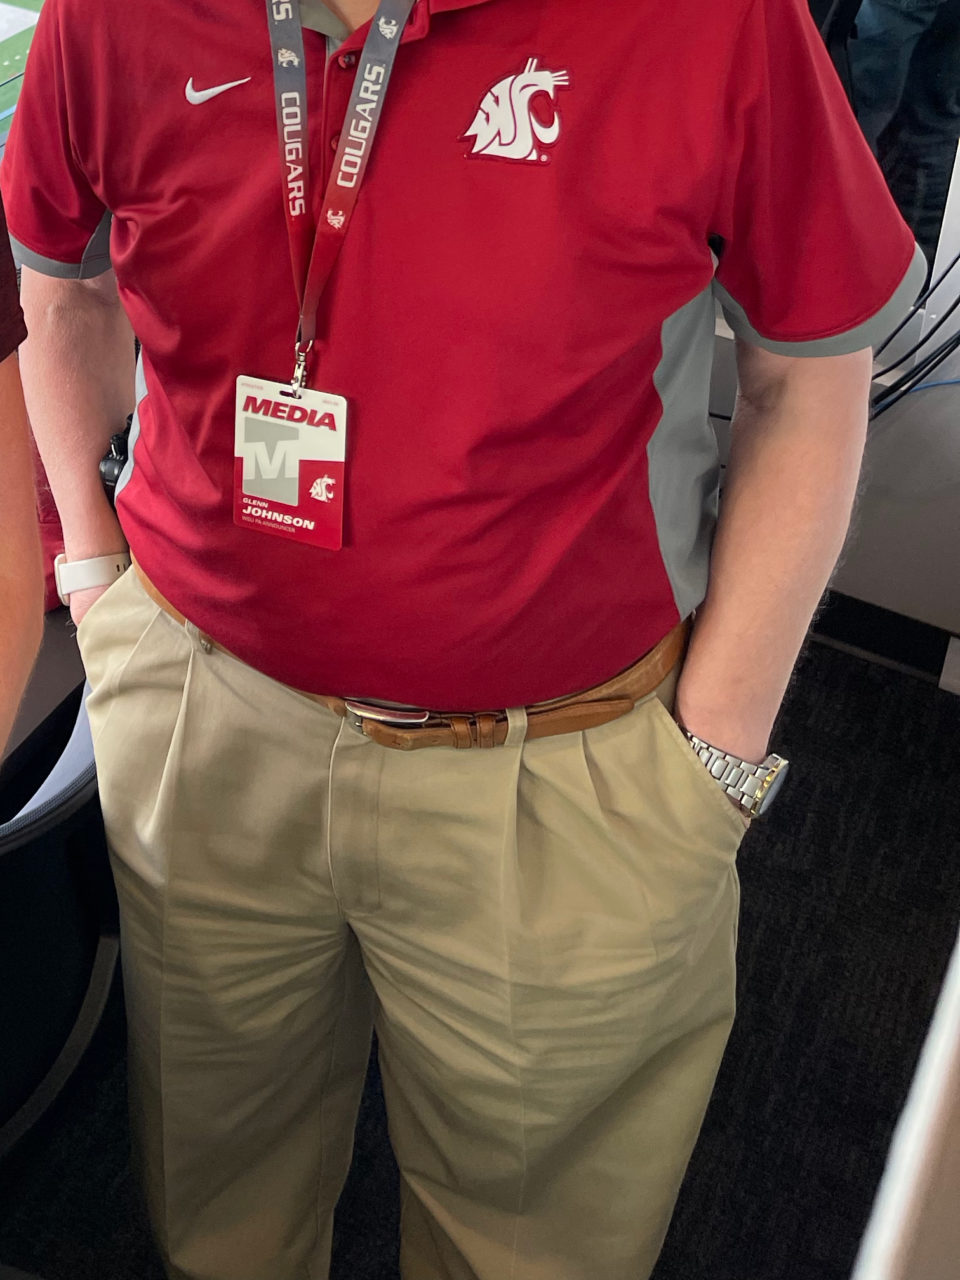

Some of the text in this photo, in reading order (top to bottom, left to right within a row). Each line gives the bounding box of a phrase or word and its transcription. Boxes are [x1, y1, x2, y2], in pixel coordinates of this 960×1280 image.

[335, 63, 385, 188] COUGARS
[281, 91, 306, 218] COUGARS
[242, 395, 337, 432] MEDIA
[242, 497, 269, 509] GLENN
[242, 505, 315, 531] JOHNSON
